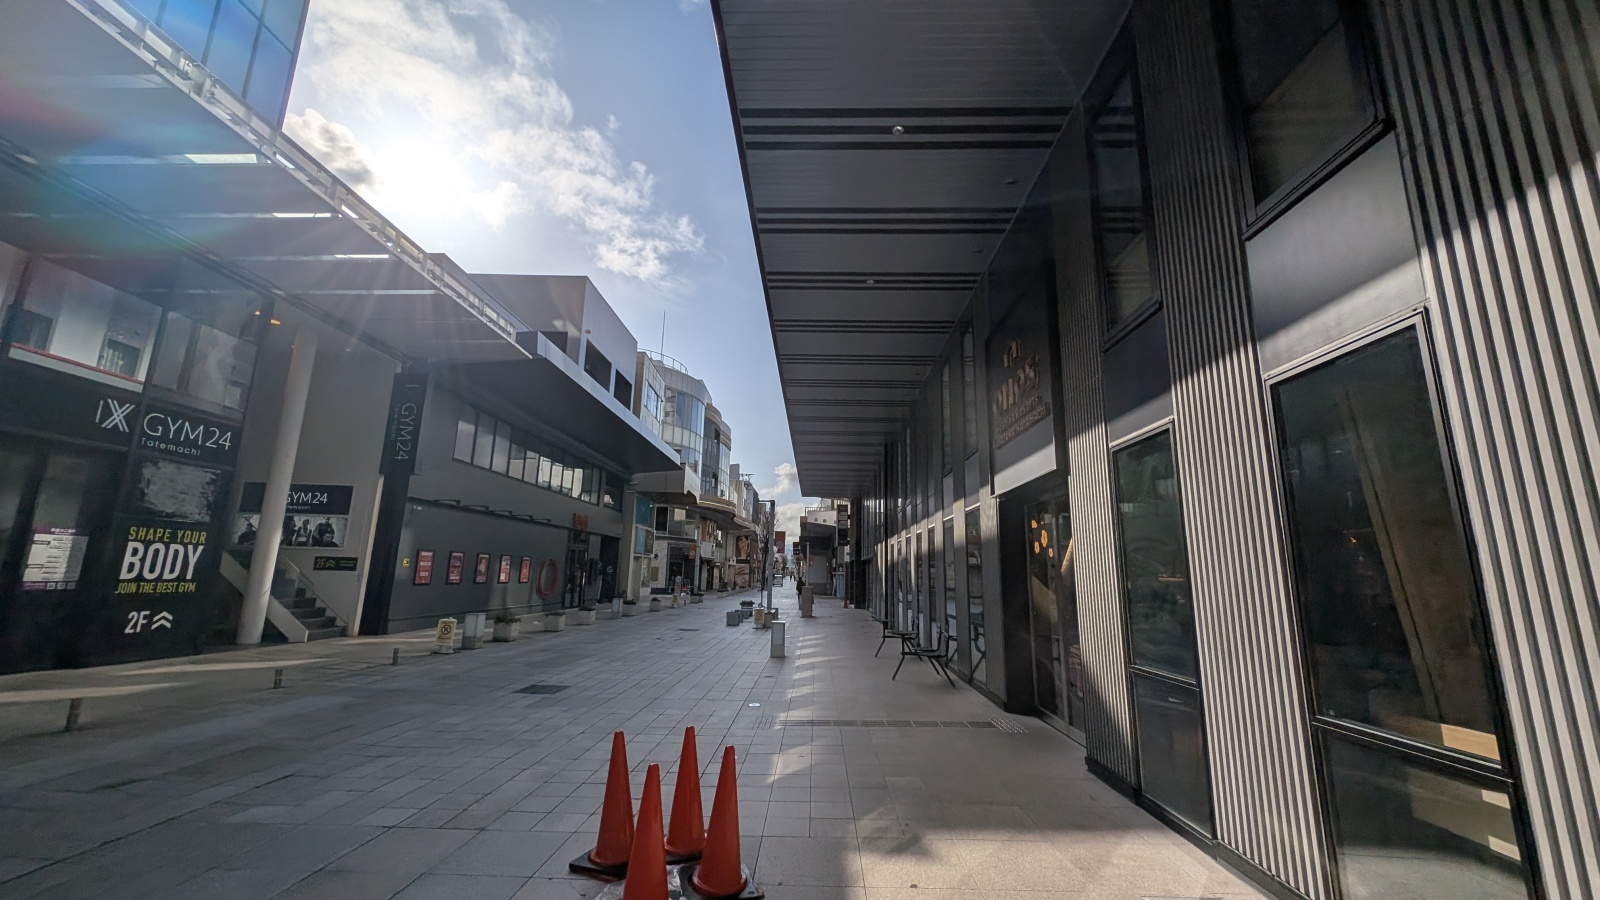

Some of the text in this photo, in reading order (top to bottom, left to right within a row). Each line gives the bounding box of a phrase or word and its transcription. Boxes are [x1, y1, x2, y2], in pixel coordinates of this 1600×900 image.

[143, 412, 232, 451] GYM24
[394, 403, 417, 461] GYM24
[142, 437, 201, 456] Tatemachi
[129, 527, 207, 544] SHAPE YOUR
[119, 542, 204, 580] BODY
[316, 558, 326, 569] 2F
[115, 582, 196, 594] JOIN THE BEST GYM
[124, 611, 151, 634] 2F
